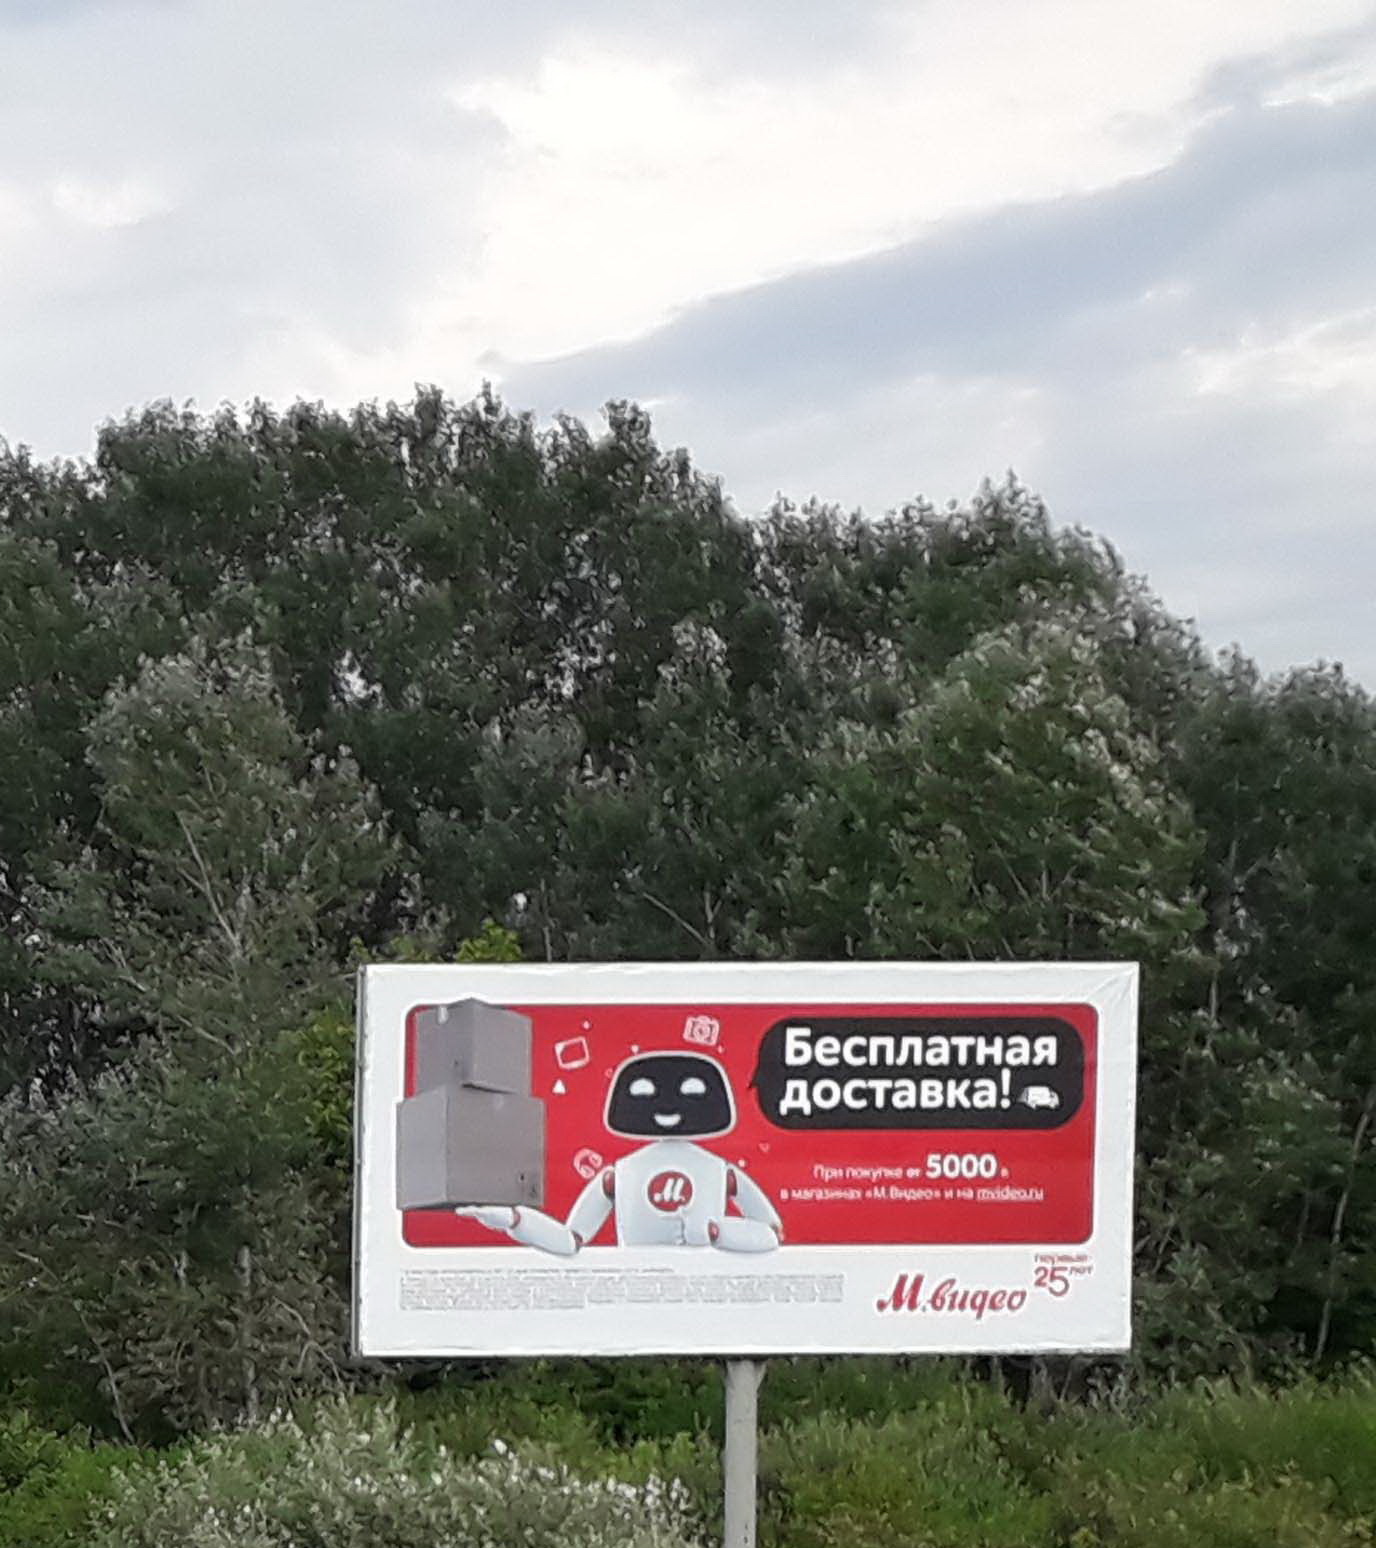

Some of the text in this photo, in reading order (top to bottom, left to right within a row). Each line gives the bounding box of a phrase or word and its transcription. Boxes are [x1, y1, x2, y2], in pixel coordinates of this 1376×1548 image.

[784, 1026, 1058, 1066] Бесплатная
[779, 1067, 1012, 1116] доставка!
[925, 1153, 998, 1179] 5000
[1034, 1265, 1070, 1297] 25
